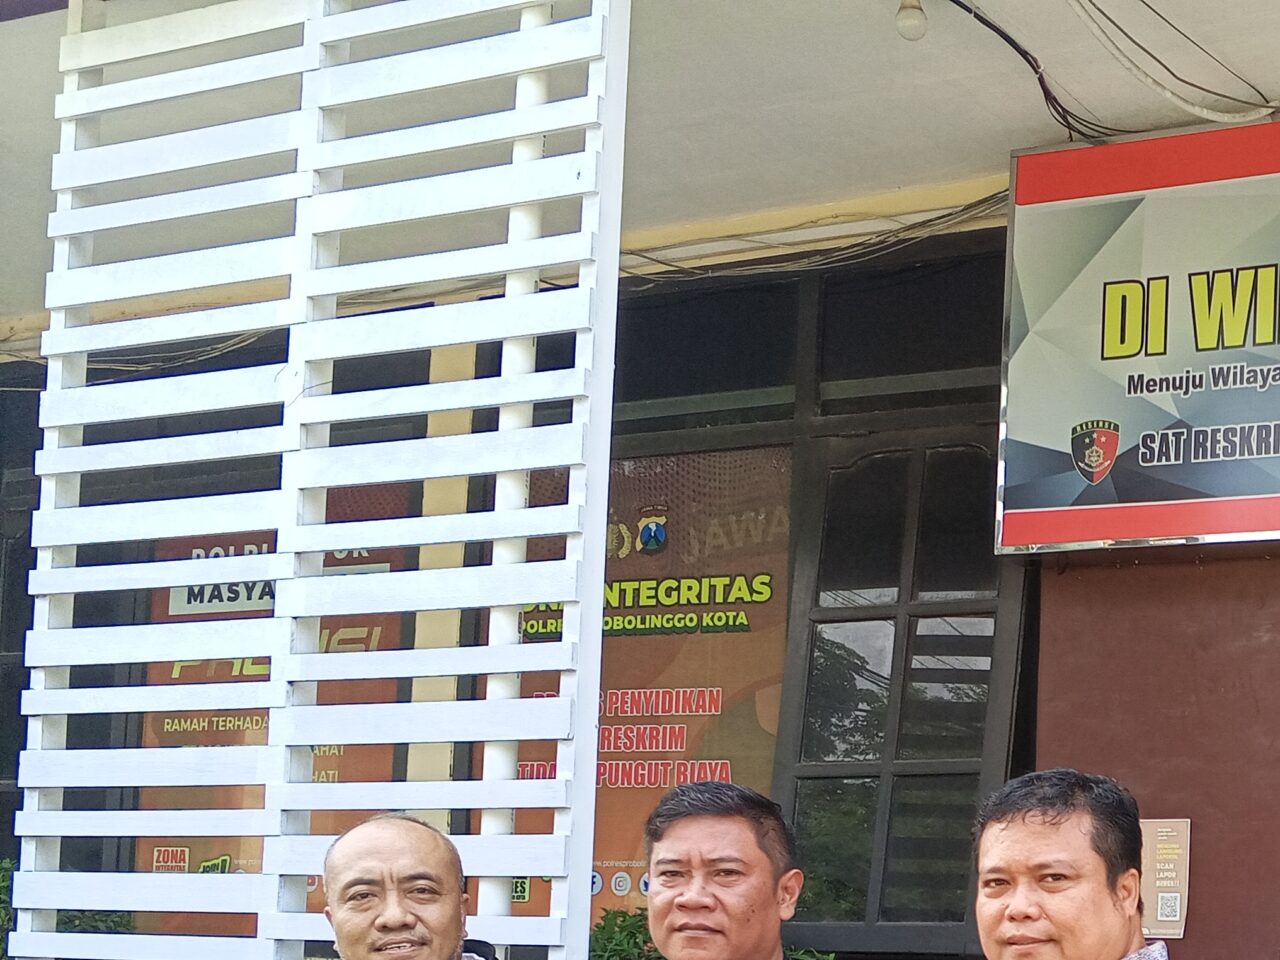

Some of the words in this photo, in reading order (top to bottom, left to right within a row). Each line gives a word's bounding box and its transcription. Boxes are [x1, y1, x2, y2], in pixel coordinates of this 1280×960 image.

[1101, 276, 1168, 361] DI
[1127, 369, 1204, 397] Menuju
[1140, 431, 1186, 466] SAT
[187, 582, 275, 605] MASYA
[604, 574, 772, 609] NTEGRITAS
[603, 612, 698, 632] OBOLINGGO
[703, 611, 749, 628] KOTA
[606, 688, 722, 717] PENYIDIKAN
[164, 718, 208, 732] RAMAH
[212, 716, 268, 731] TERHADA
[600, 725, 687, 753] RESKRIM
[675, 760, 732, 787] BIAYA
[155, 848, 186, 865] ZONA
